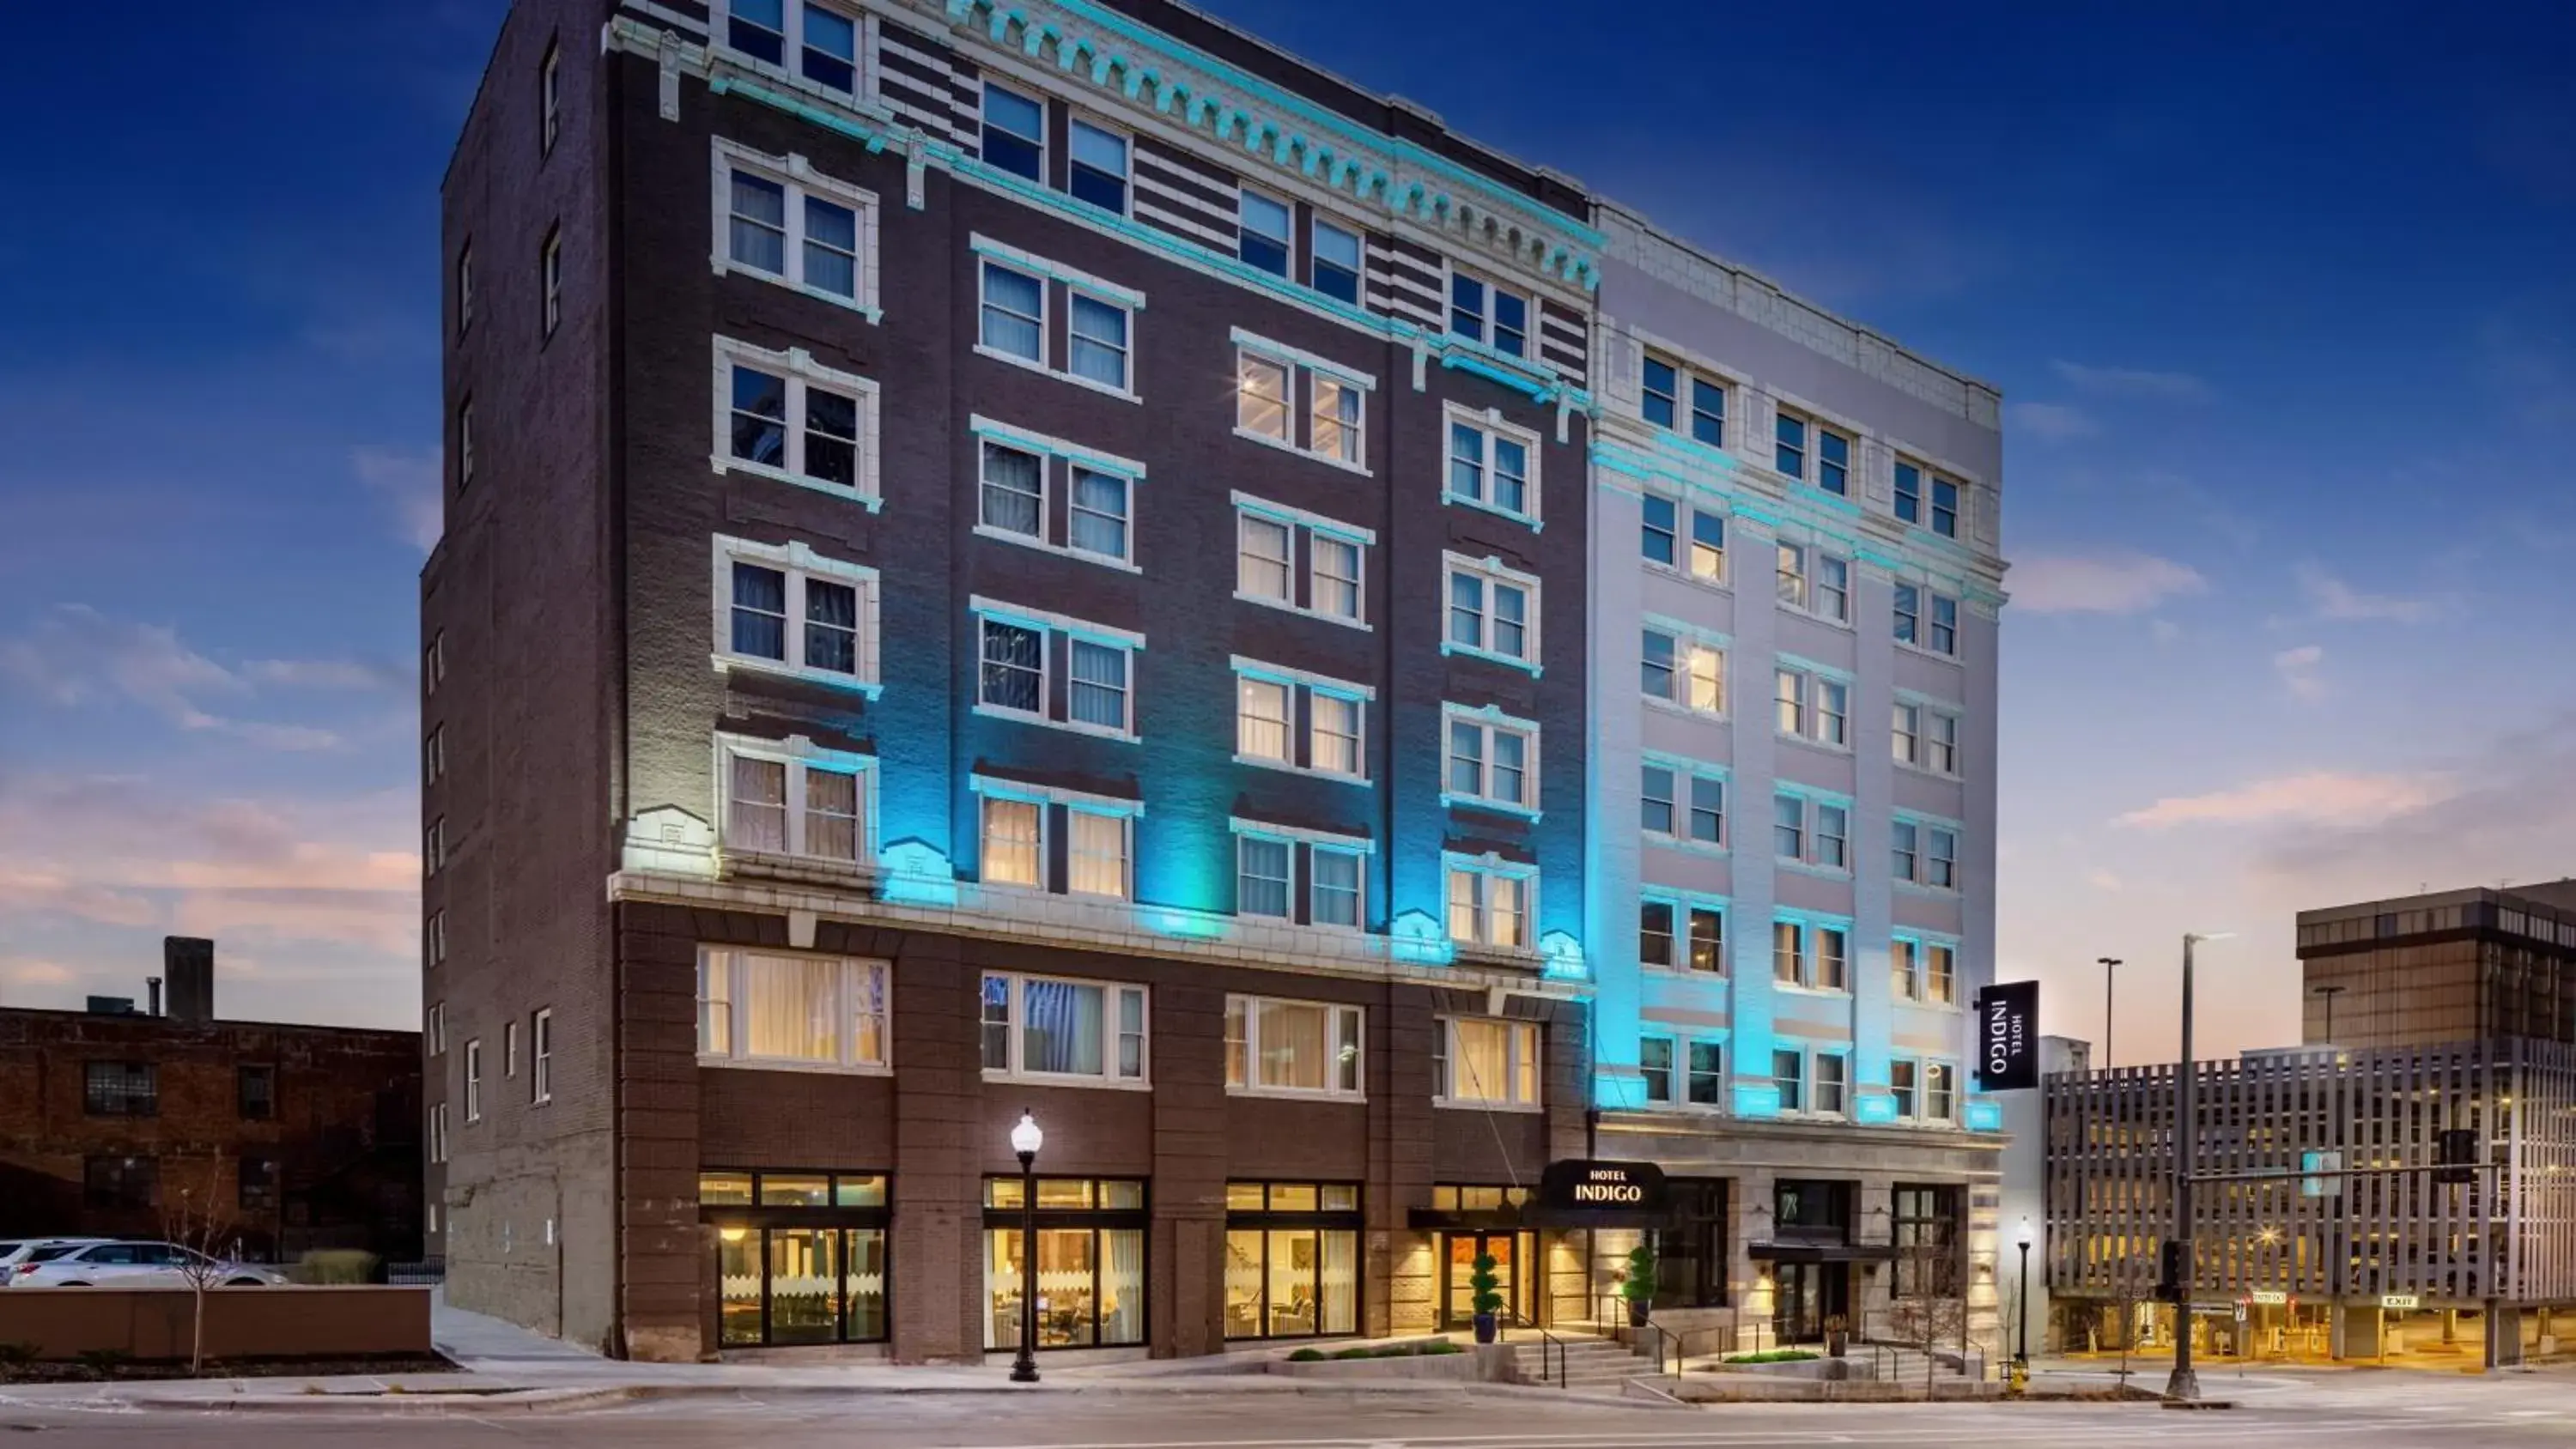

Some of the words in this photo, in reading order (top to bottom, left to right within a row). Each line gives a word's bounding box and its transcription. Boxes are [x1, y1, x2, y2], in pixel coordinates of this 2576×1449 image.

[1991, 1000, 2007, 1074] INDIGO
[2012, 1014, 2022, 1056] HOTEL
[1590, 1170, 1627, 1180] HOTEL
[1575, 1185, 1642, 1201] INDIGO
